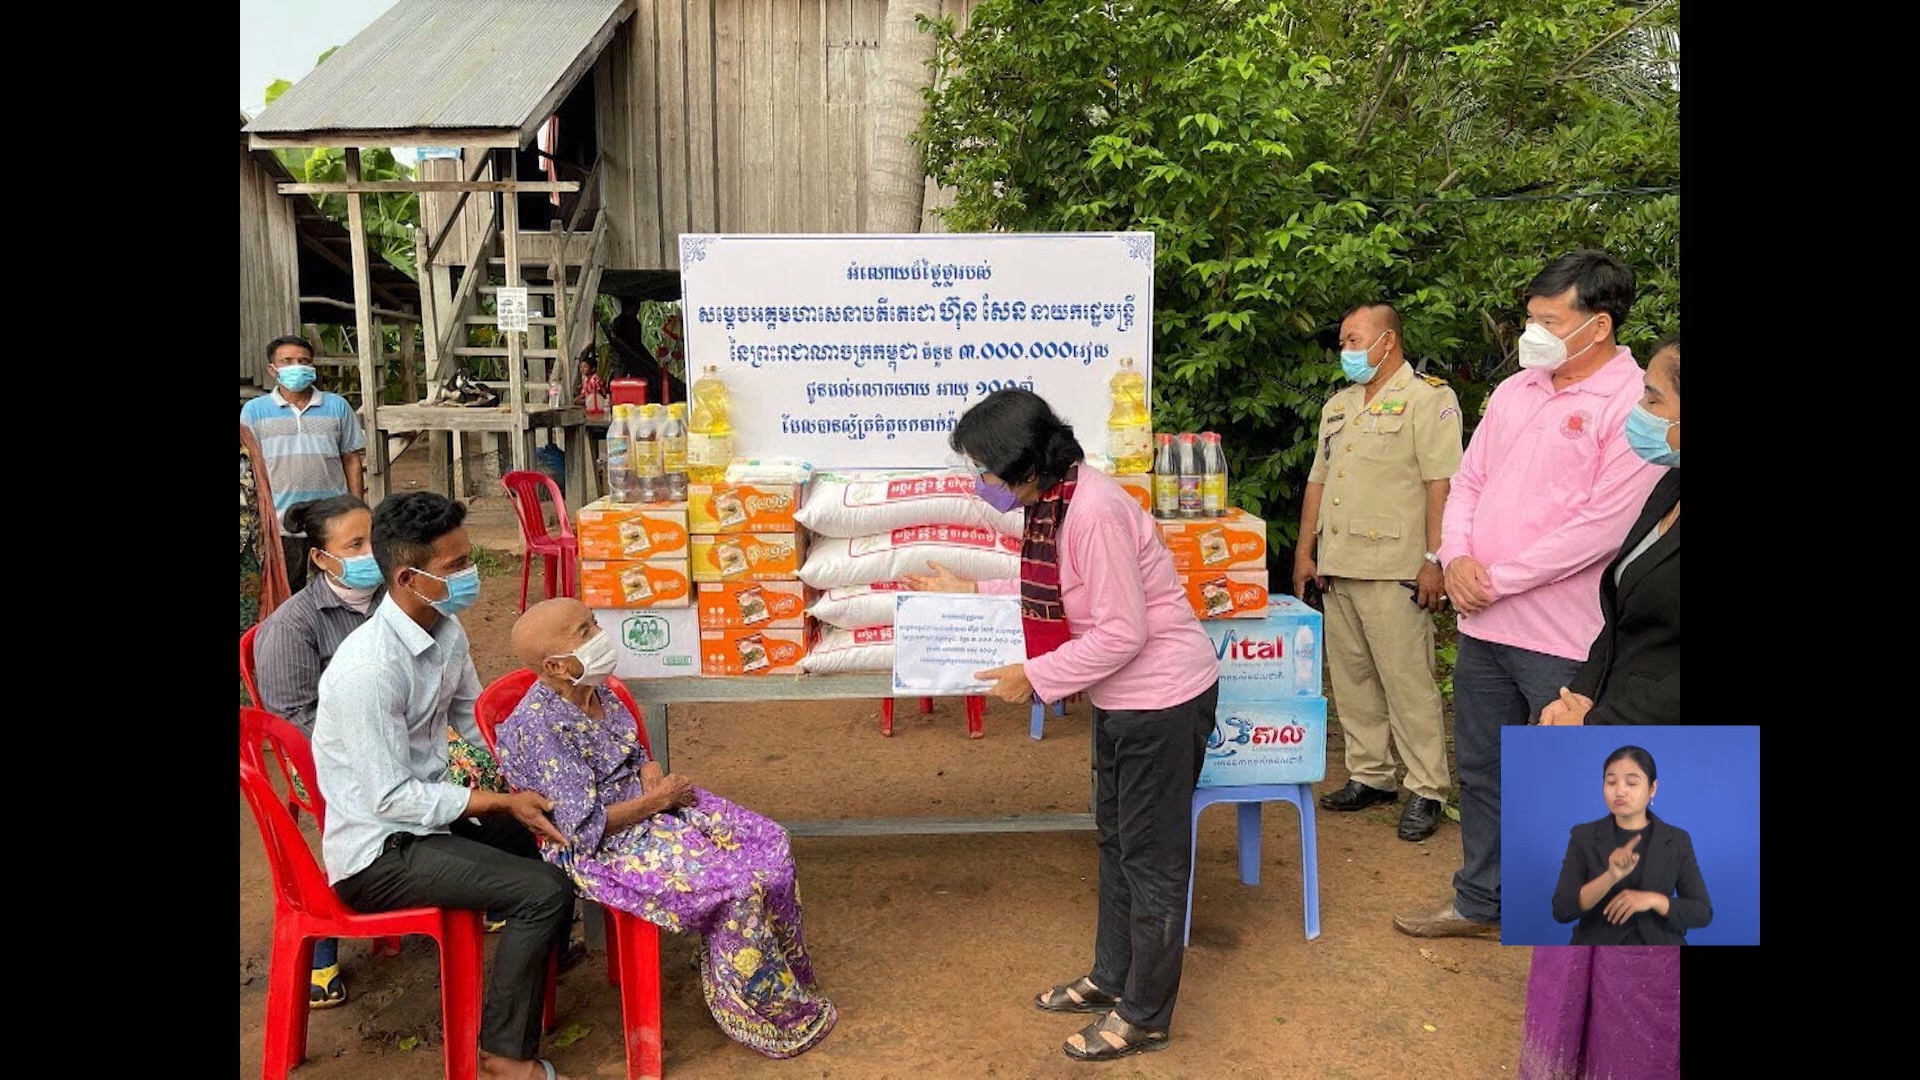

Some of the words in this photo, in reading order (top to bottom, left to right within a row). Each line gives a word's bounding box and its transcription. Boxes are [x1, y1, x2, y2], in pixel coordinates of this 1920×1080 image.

[939, 296, 978, 330] ហ៊ុន
[982, 293, 1027, 322] សែន
[936, 381, 969, 402] អាយុ
[1209, 629, 1284, 660] Vital
